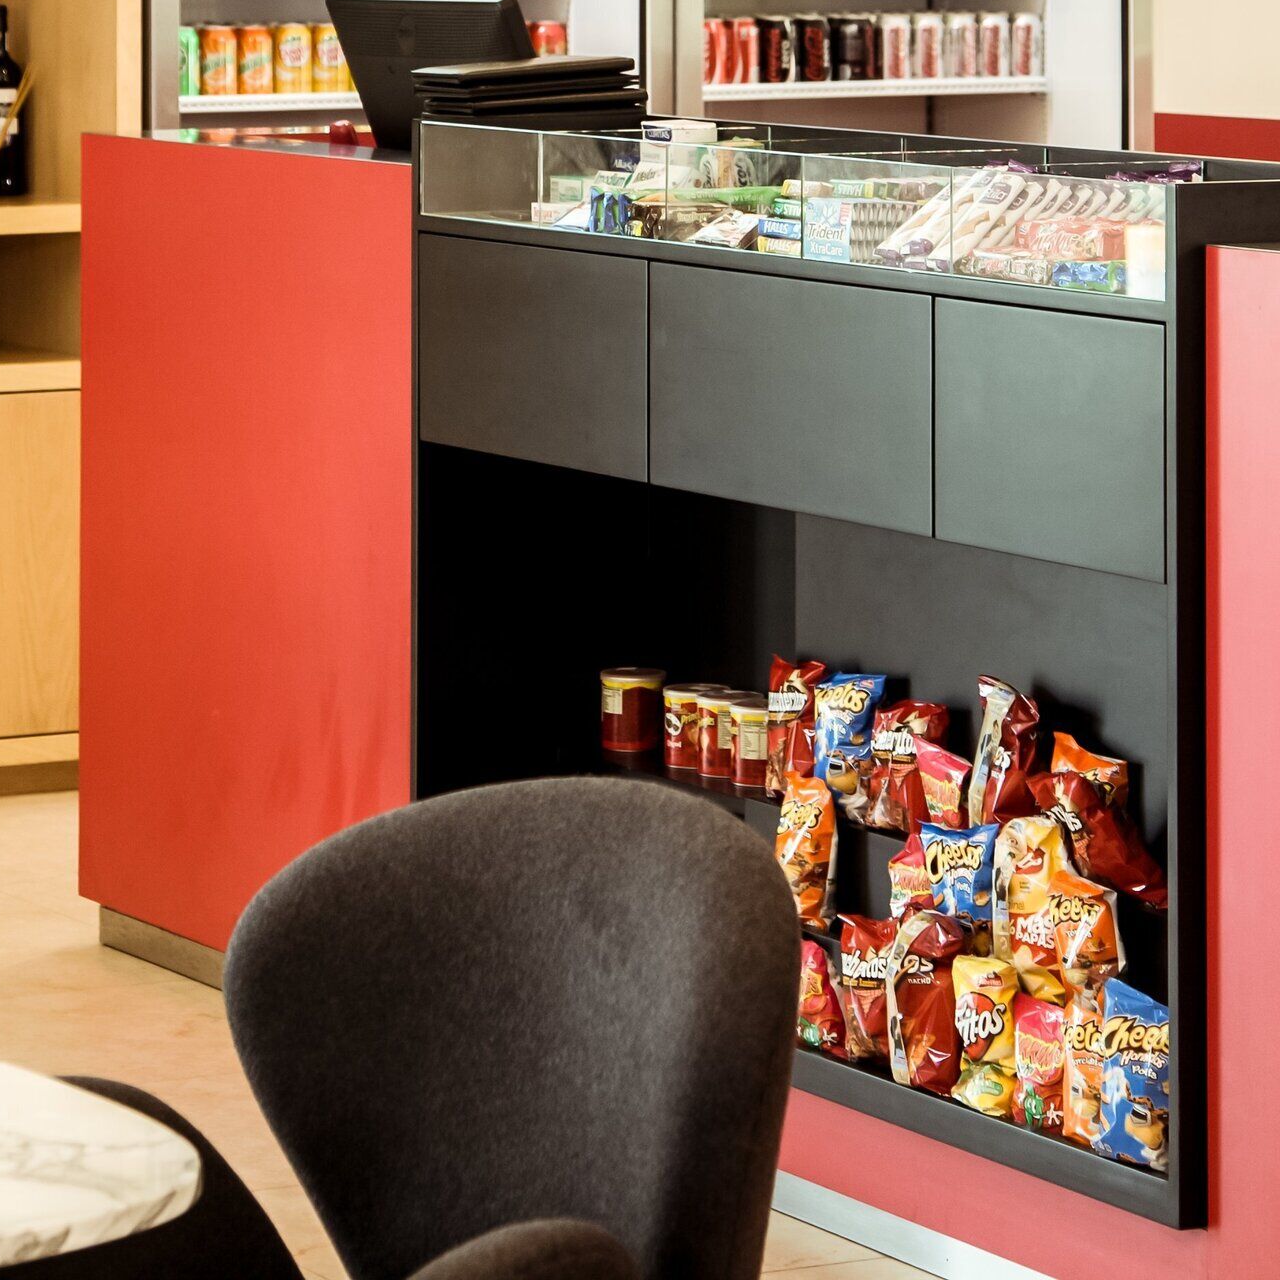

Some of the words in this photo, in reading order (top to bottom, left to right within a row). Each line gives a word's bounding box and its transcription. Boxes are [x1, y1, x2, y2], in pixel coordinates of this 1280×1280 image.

[764, 220, 789, 234] HALLS
[809, 223, 845, 241] Trident
[925, 839, 984, 885] Cheetos
[1016, 932, 1055, 951] PAPAS
